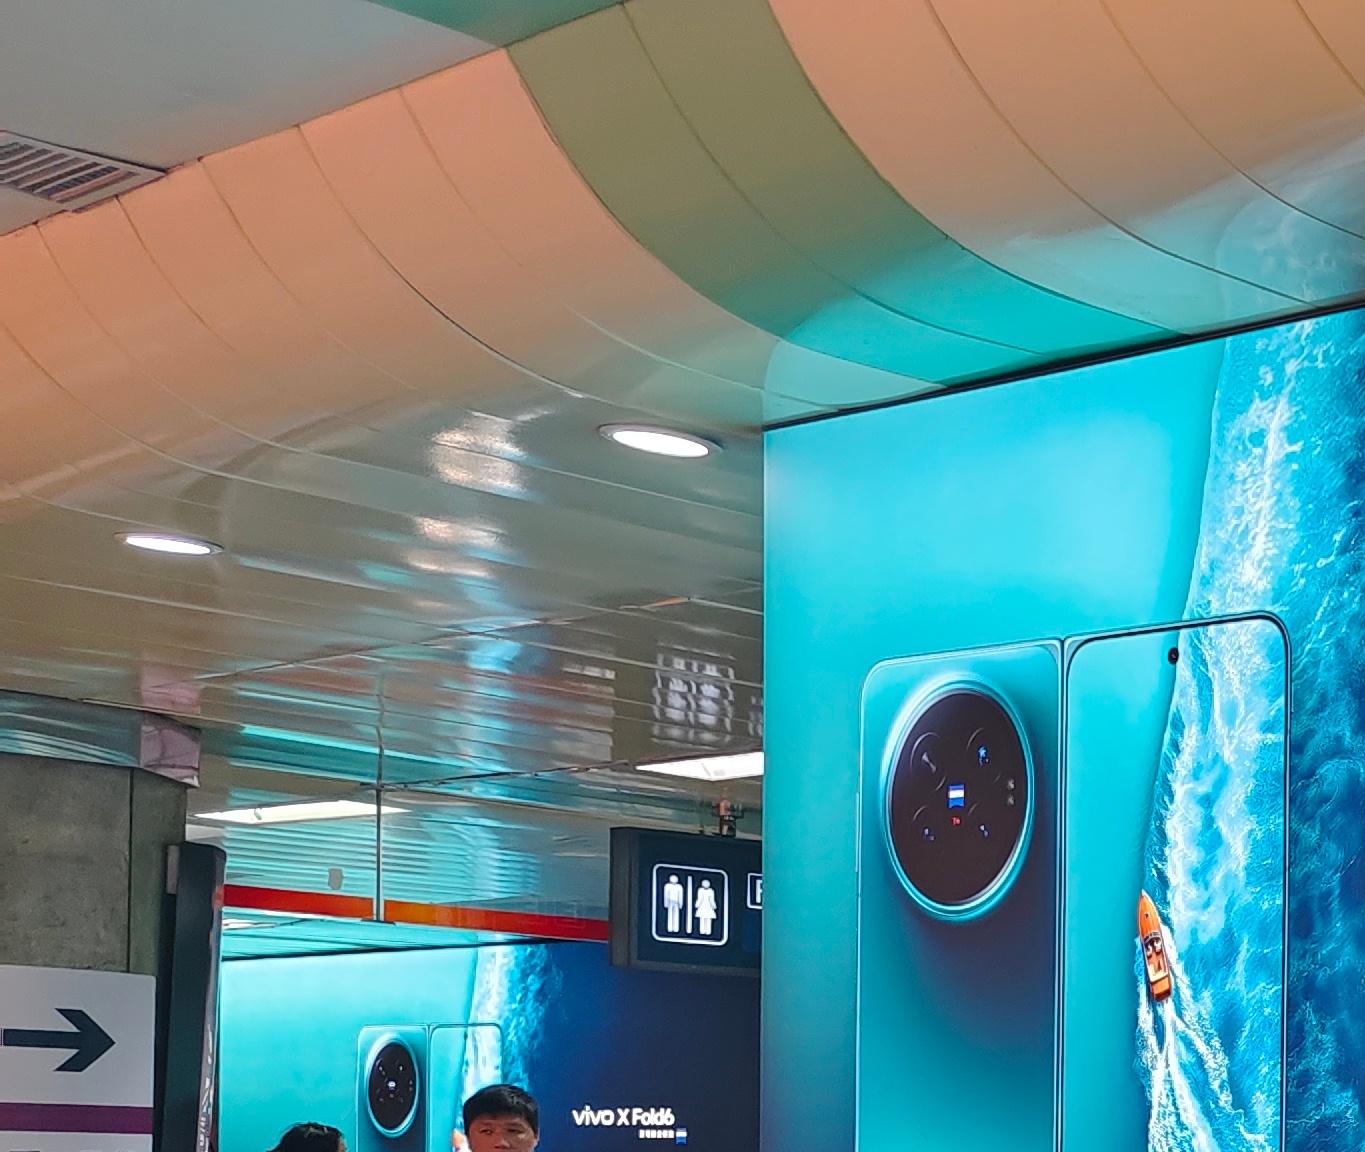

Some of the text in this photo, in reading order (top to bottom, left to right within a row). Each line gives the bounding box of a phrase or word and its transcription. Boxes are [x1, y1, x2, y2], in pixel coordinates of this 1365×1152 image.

[572, 1105, 676, 1126] vivo X Fold6
